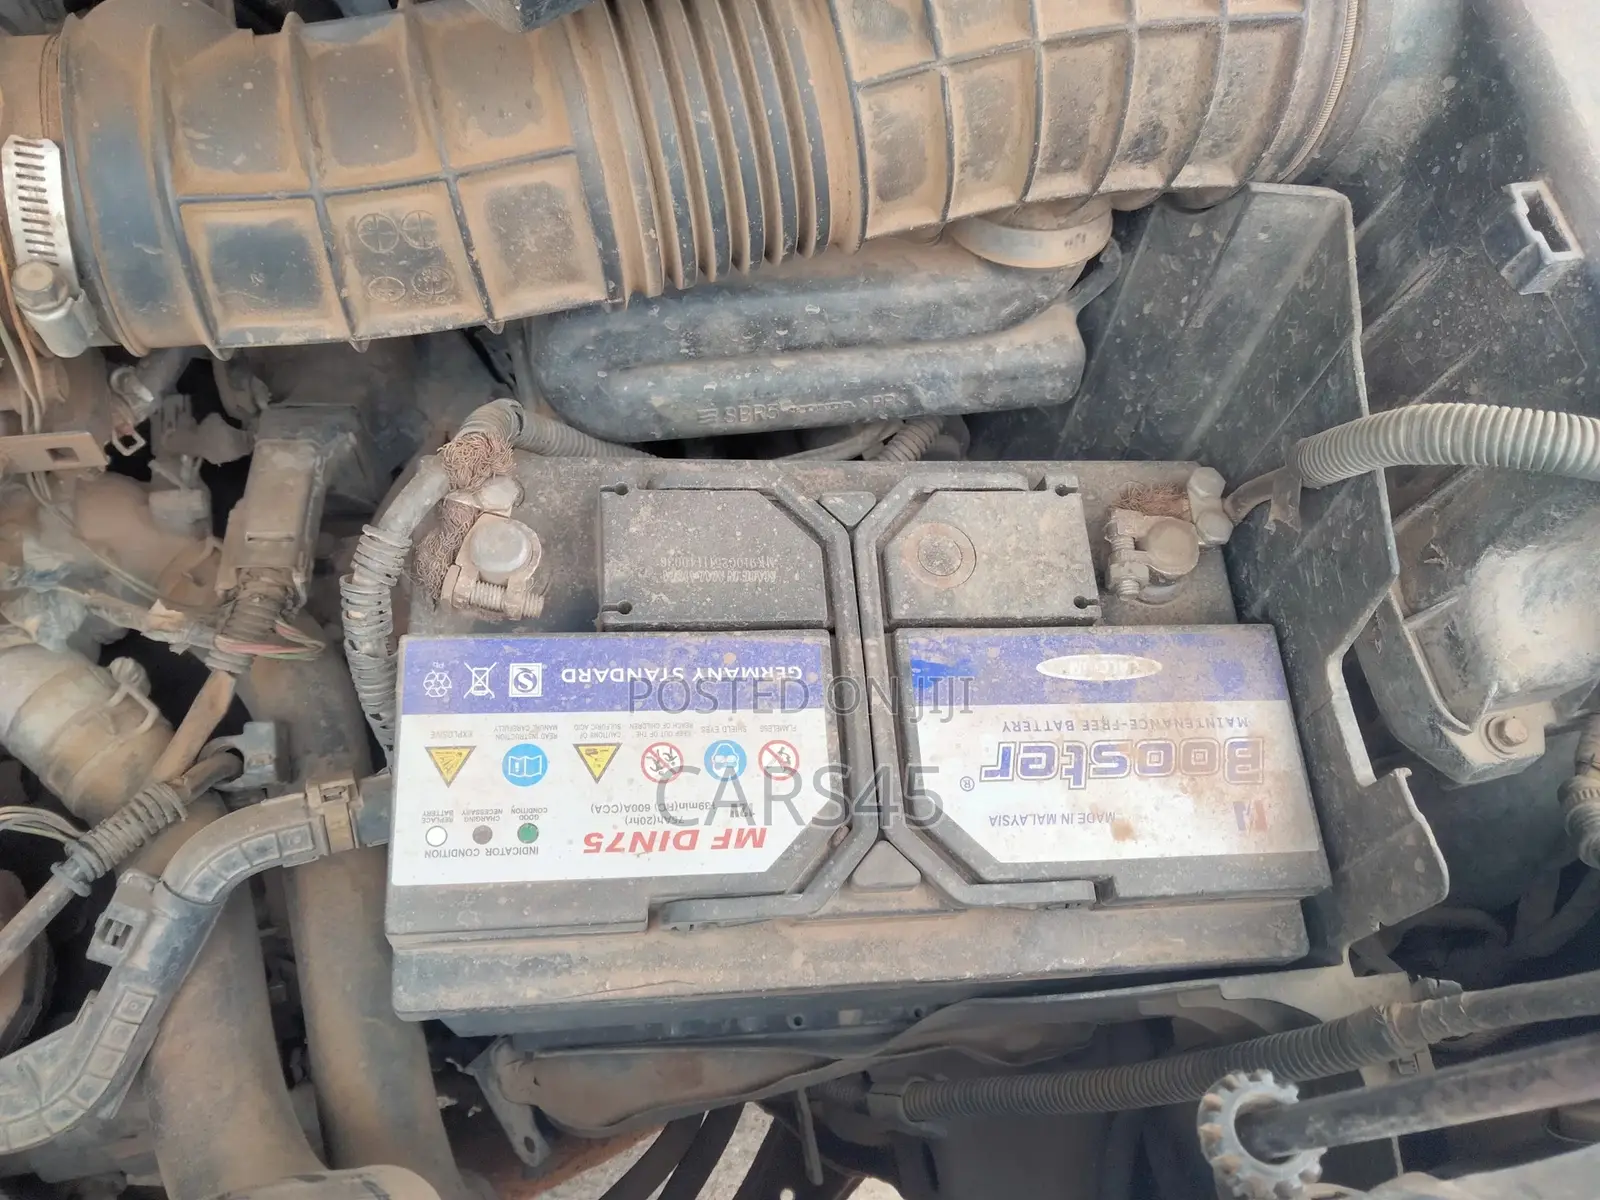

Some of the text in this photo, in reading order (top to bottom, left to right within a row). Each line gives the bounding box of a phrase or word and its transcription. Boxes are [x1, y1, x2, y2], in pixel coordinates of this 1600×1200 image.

[561, 665, 802, 683] GERMANY STANDARD
[494, 724, 530, 733] CAREFULLY
[574, 723, 588, 731] ACID
[629, 722, 661, 730] CHILDREN
[760, 724, 797, 733] FLAMELESS
[1002, 716, 1248, 733] MAINTENANCE-FREE BATTERY
[635, 730, 647, 738] THE
[701, 725, 747, 734] SHIELD EYES
[430, 730, 473, 739] EXPLOSIVE
[495, 733, 538, 741] INSTRUCTION
[979, 737, 1265, 791] Booster
[461, 808, 502, 816] NECESSARY
[511, 806, 548, 815] CONDITION
[591, 802, 651, 815] 600A(CCA)
[730, 803, 755, 818] 12V
[422, 816, 453, 824] REPLACE
[464, 814, 500, 822] CHARGING
[519, 813, 539, 821] GOOD
[624, 815, 685, 826] 75Ah(20hr)
[988, 811, 1116, 827] MADE IN MALAYSIA
[583, 827, 767, 854] MF DIN75
[424, 847, 539, 858] INDICATOR CONDITION
